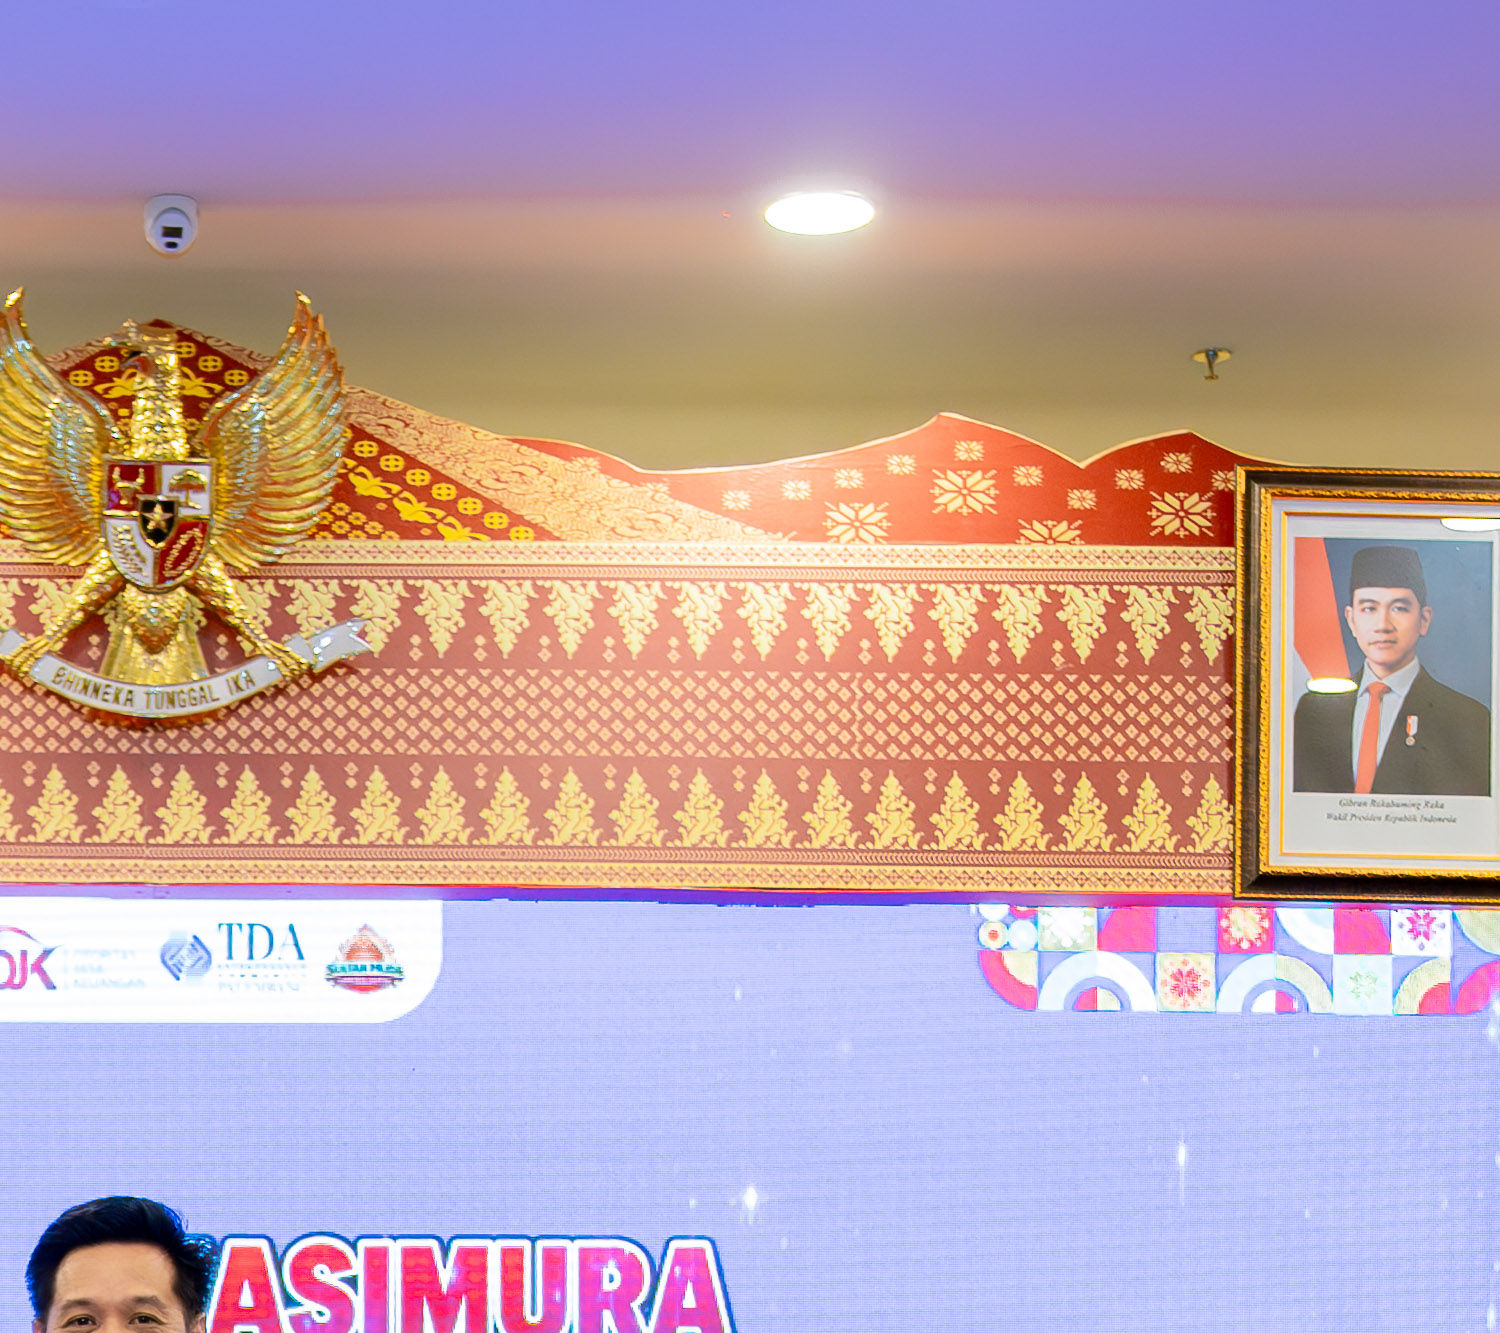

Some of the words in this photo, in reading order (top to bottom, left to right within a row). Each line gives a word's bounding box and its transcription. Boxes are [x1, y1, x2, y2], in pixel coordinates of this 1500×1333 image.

[52, 666, 134, 708] BHINNEKA
[145, 683, 220, 710] TUNGGAL
[226, 670, 256, 696] IKA
[217, 922, 306, 960] TDA
